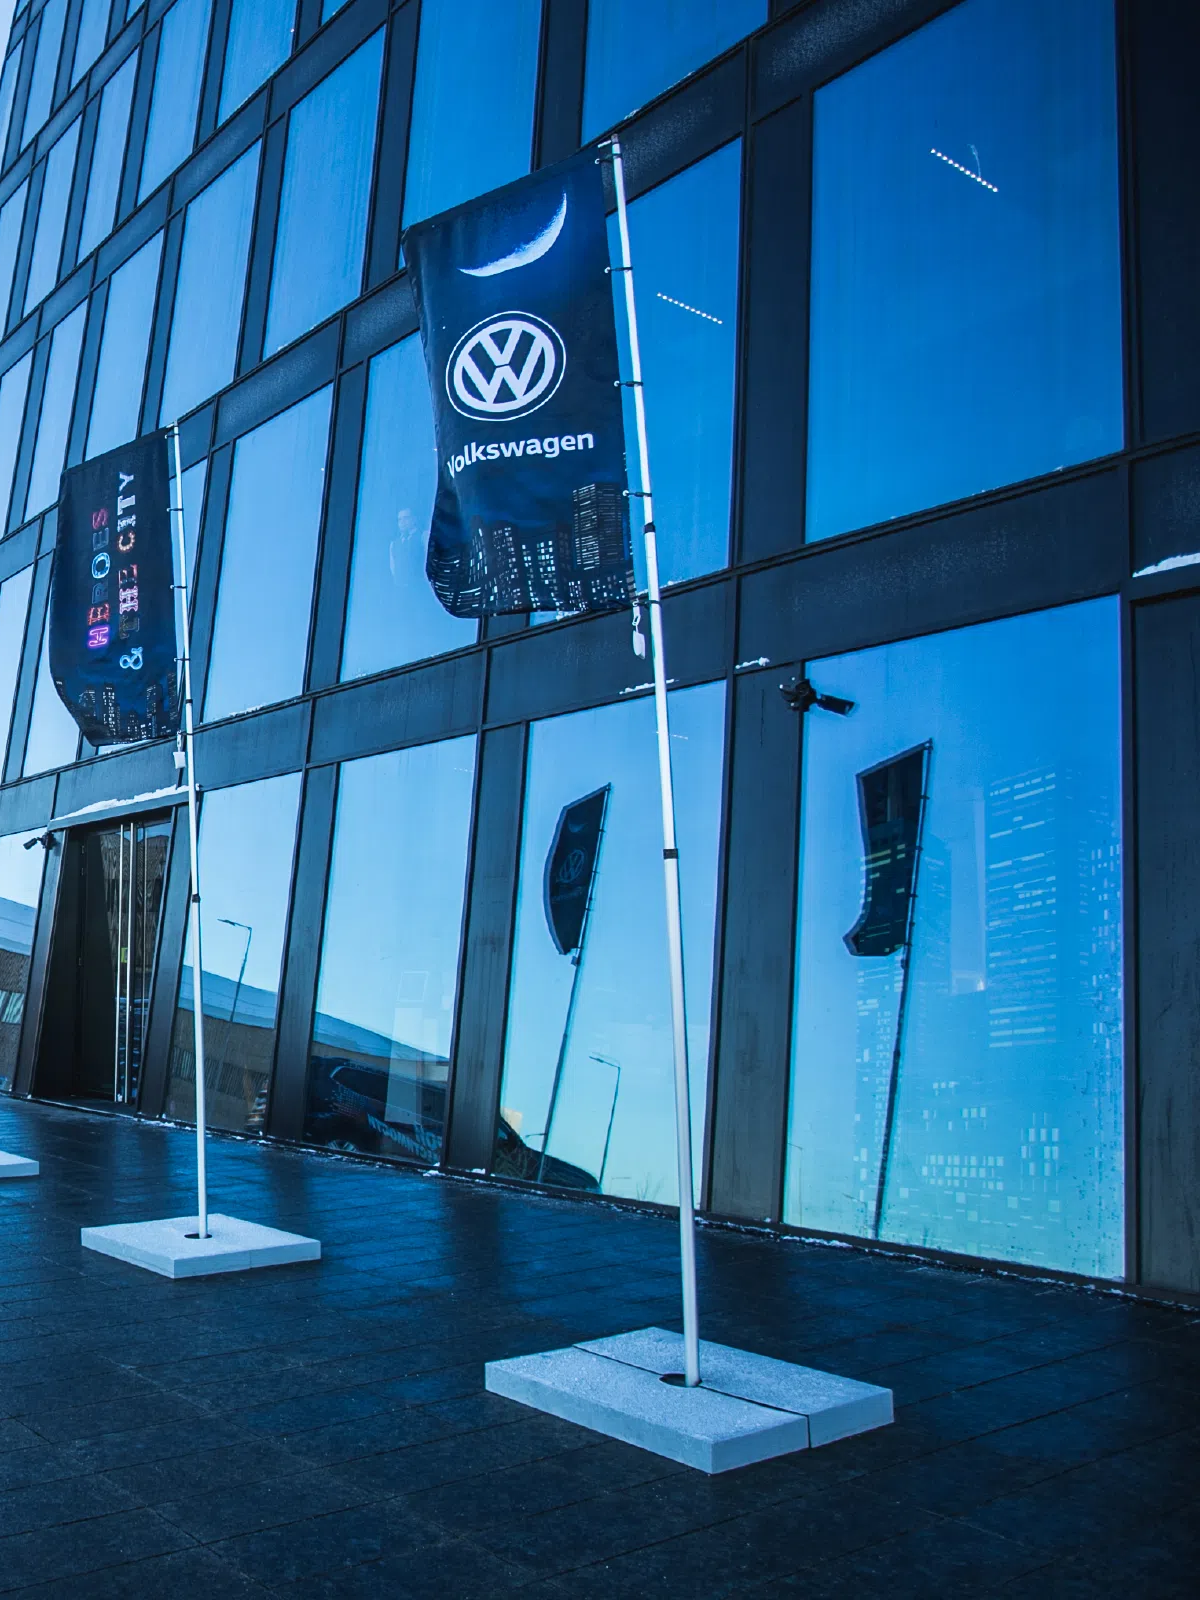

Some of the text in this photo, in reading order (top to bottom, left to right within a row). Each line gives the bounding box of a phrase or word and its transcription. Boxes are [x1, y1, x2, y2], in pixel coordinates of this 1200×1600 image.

[453, 319, 556, 413] VW
[447, 432, 595, 479] Volkswagen
[88, 508, 111, 647] HEROES
[117, 471, 144, 670] & THE CITY
